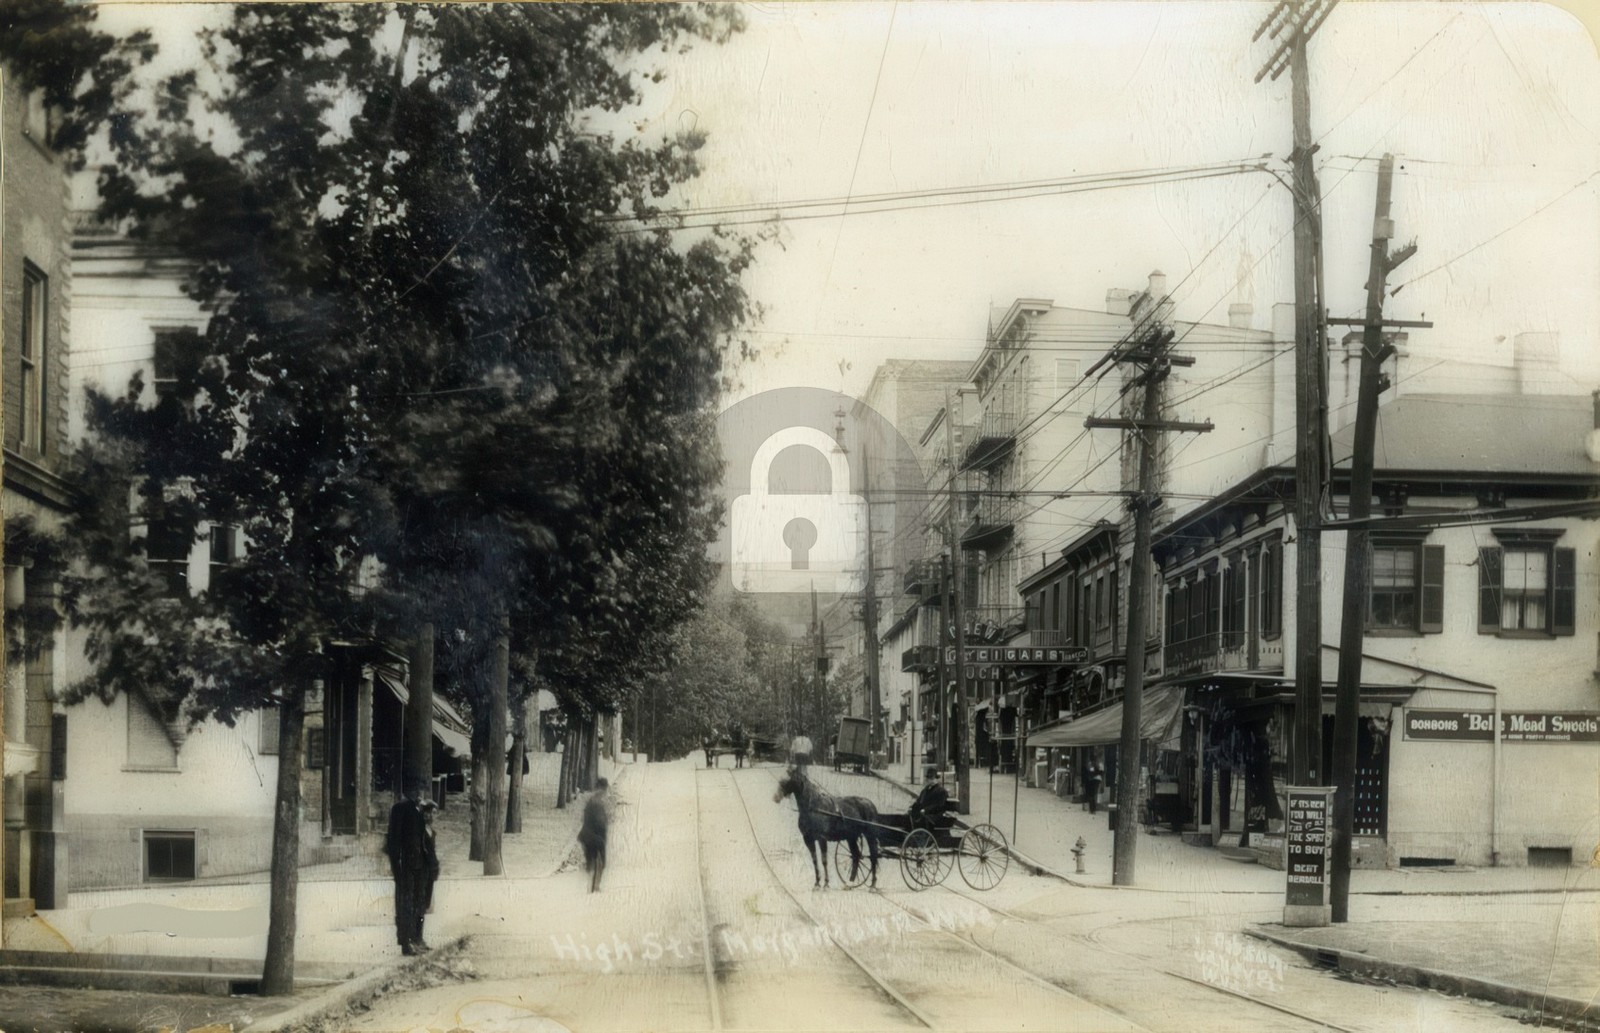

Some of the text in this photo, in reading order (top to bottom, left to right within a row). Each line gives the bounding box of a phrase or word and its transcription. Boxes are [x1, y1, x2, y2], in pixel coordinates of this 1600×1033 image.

[979, 649, 1058, 660] CIGARS
[1410, 719, 1459, 731] BONBONS
[1306, 811, 1324, 820] WILL
[1289, 844, 1325, 855] TO BUY
